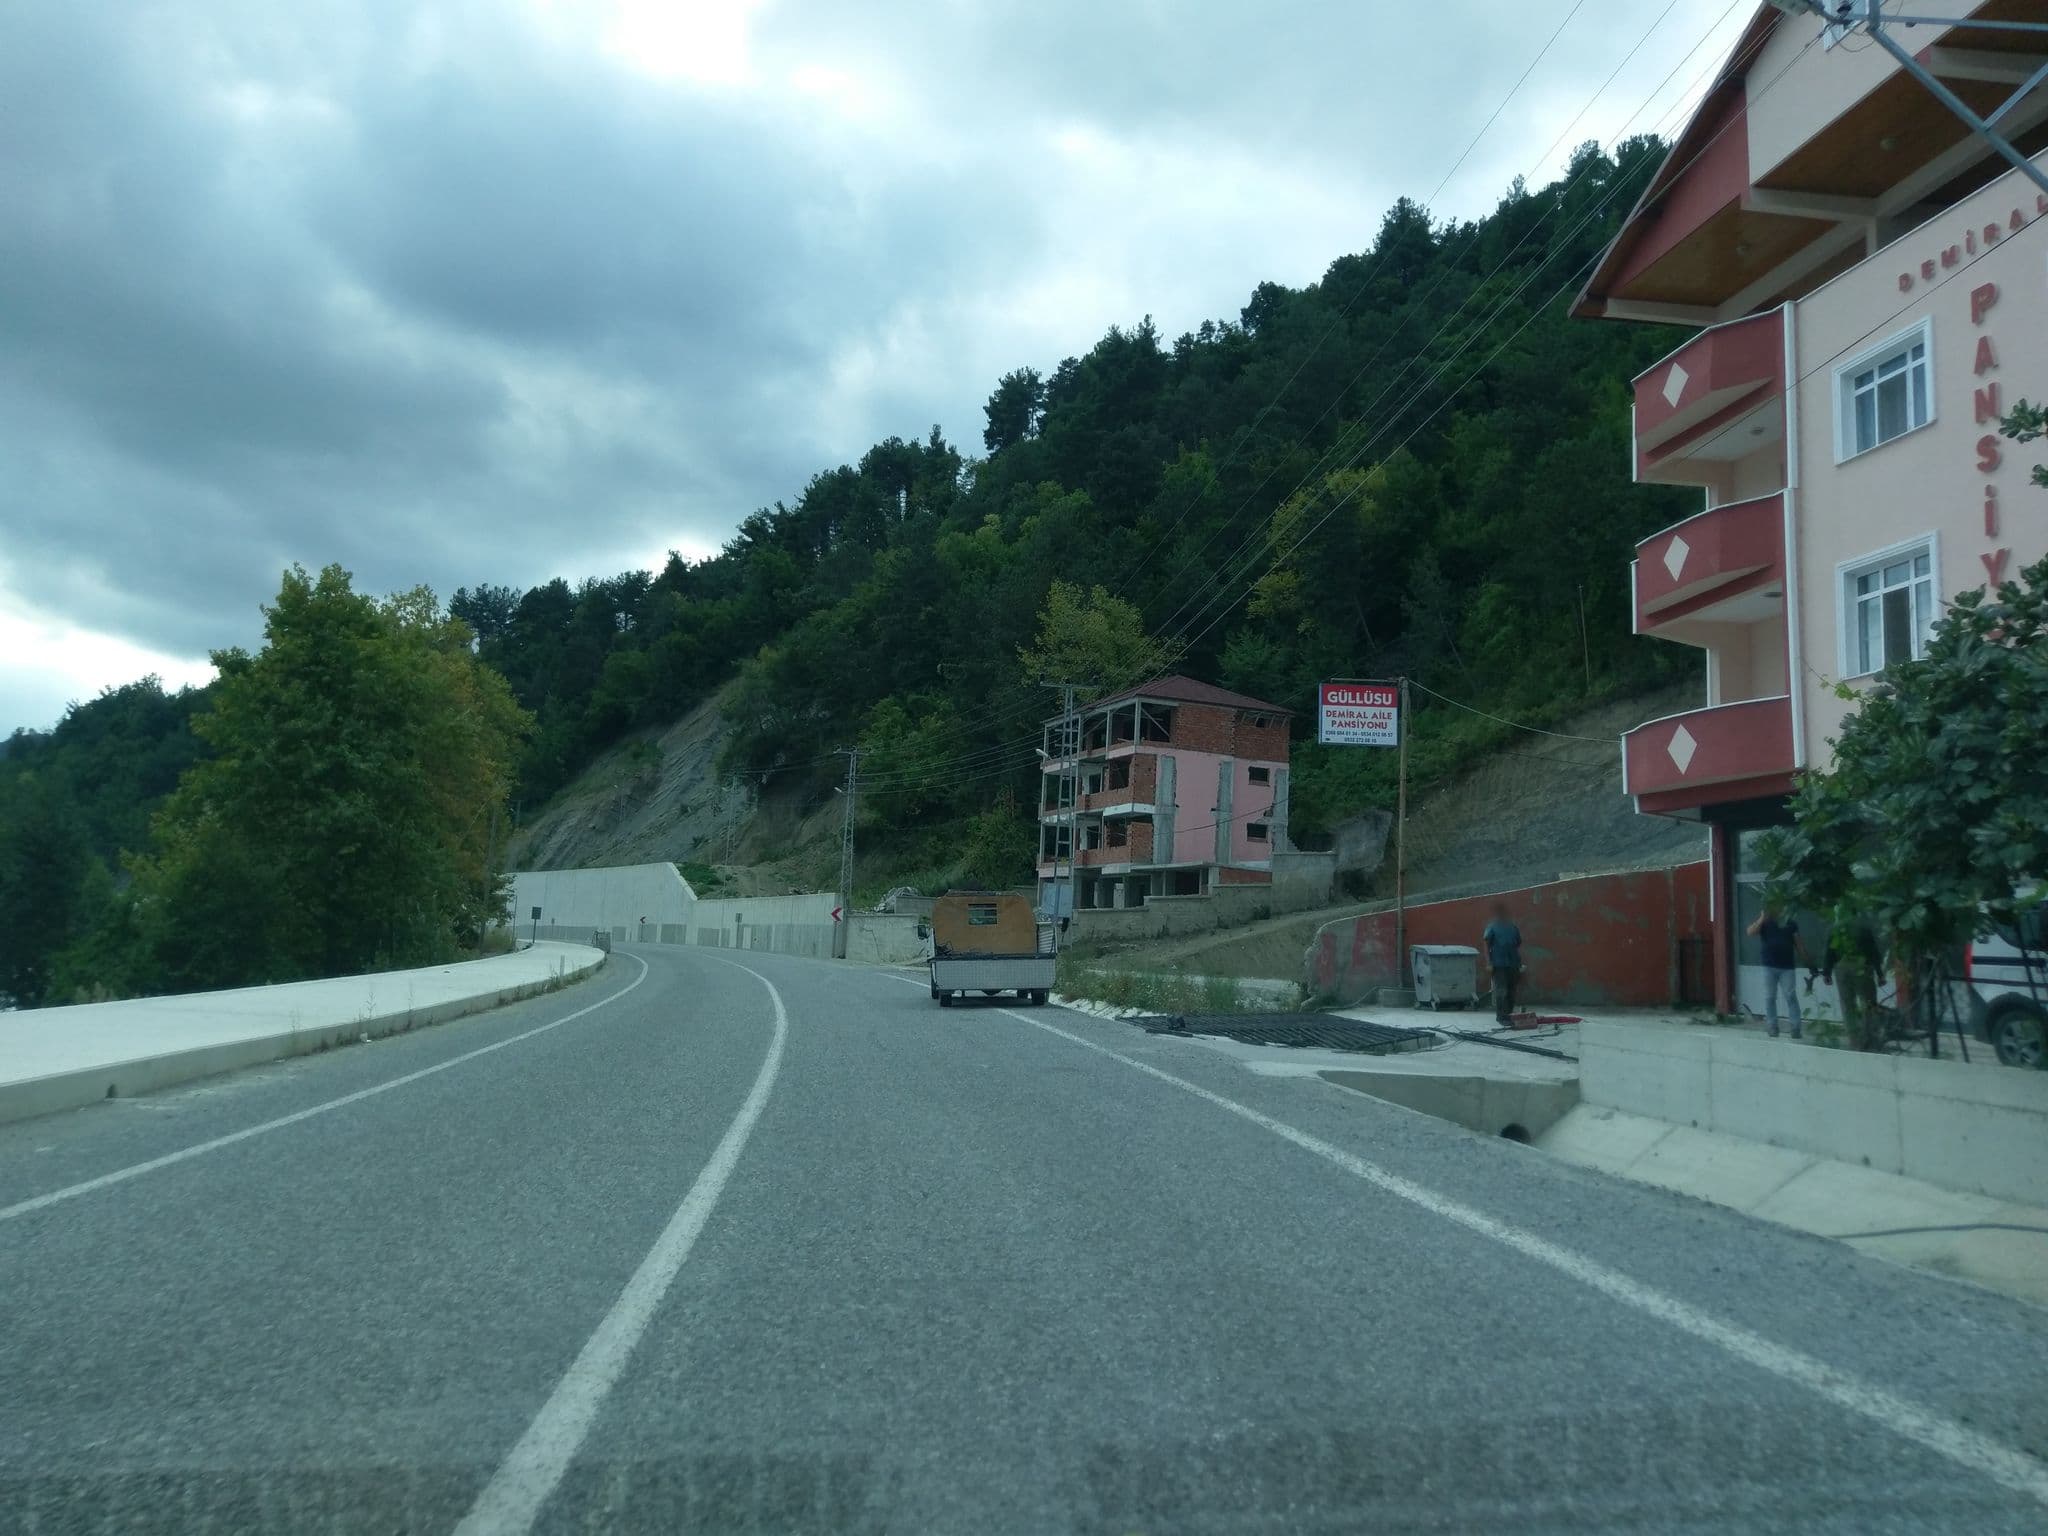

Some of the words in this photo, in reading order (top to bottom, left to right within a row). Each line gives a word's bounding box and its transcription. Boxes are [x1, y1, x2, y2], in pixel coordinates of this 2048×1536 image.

[1328, 689, 1392, 705] GÜLLÜSU
[1326, 710, 1368, 718] DEMİRAL
[1372, 711, 1392, 719] AİLE
[1332, 719, 1387, 729] PANSİYONU
